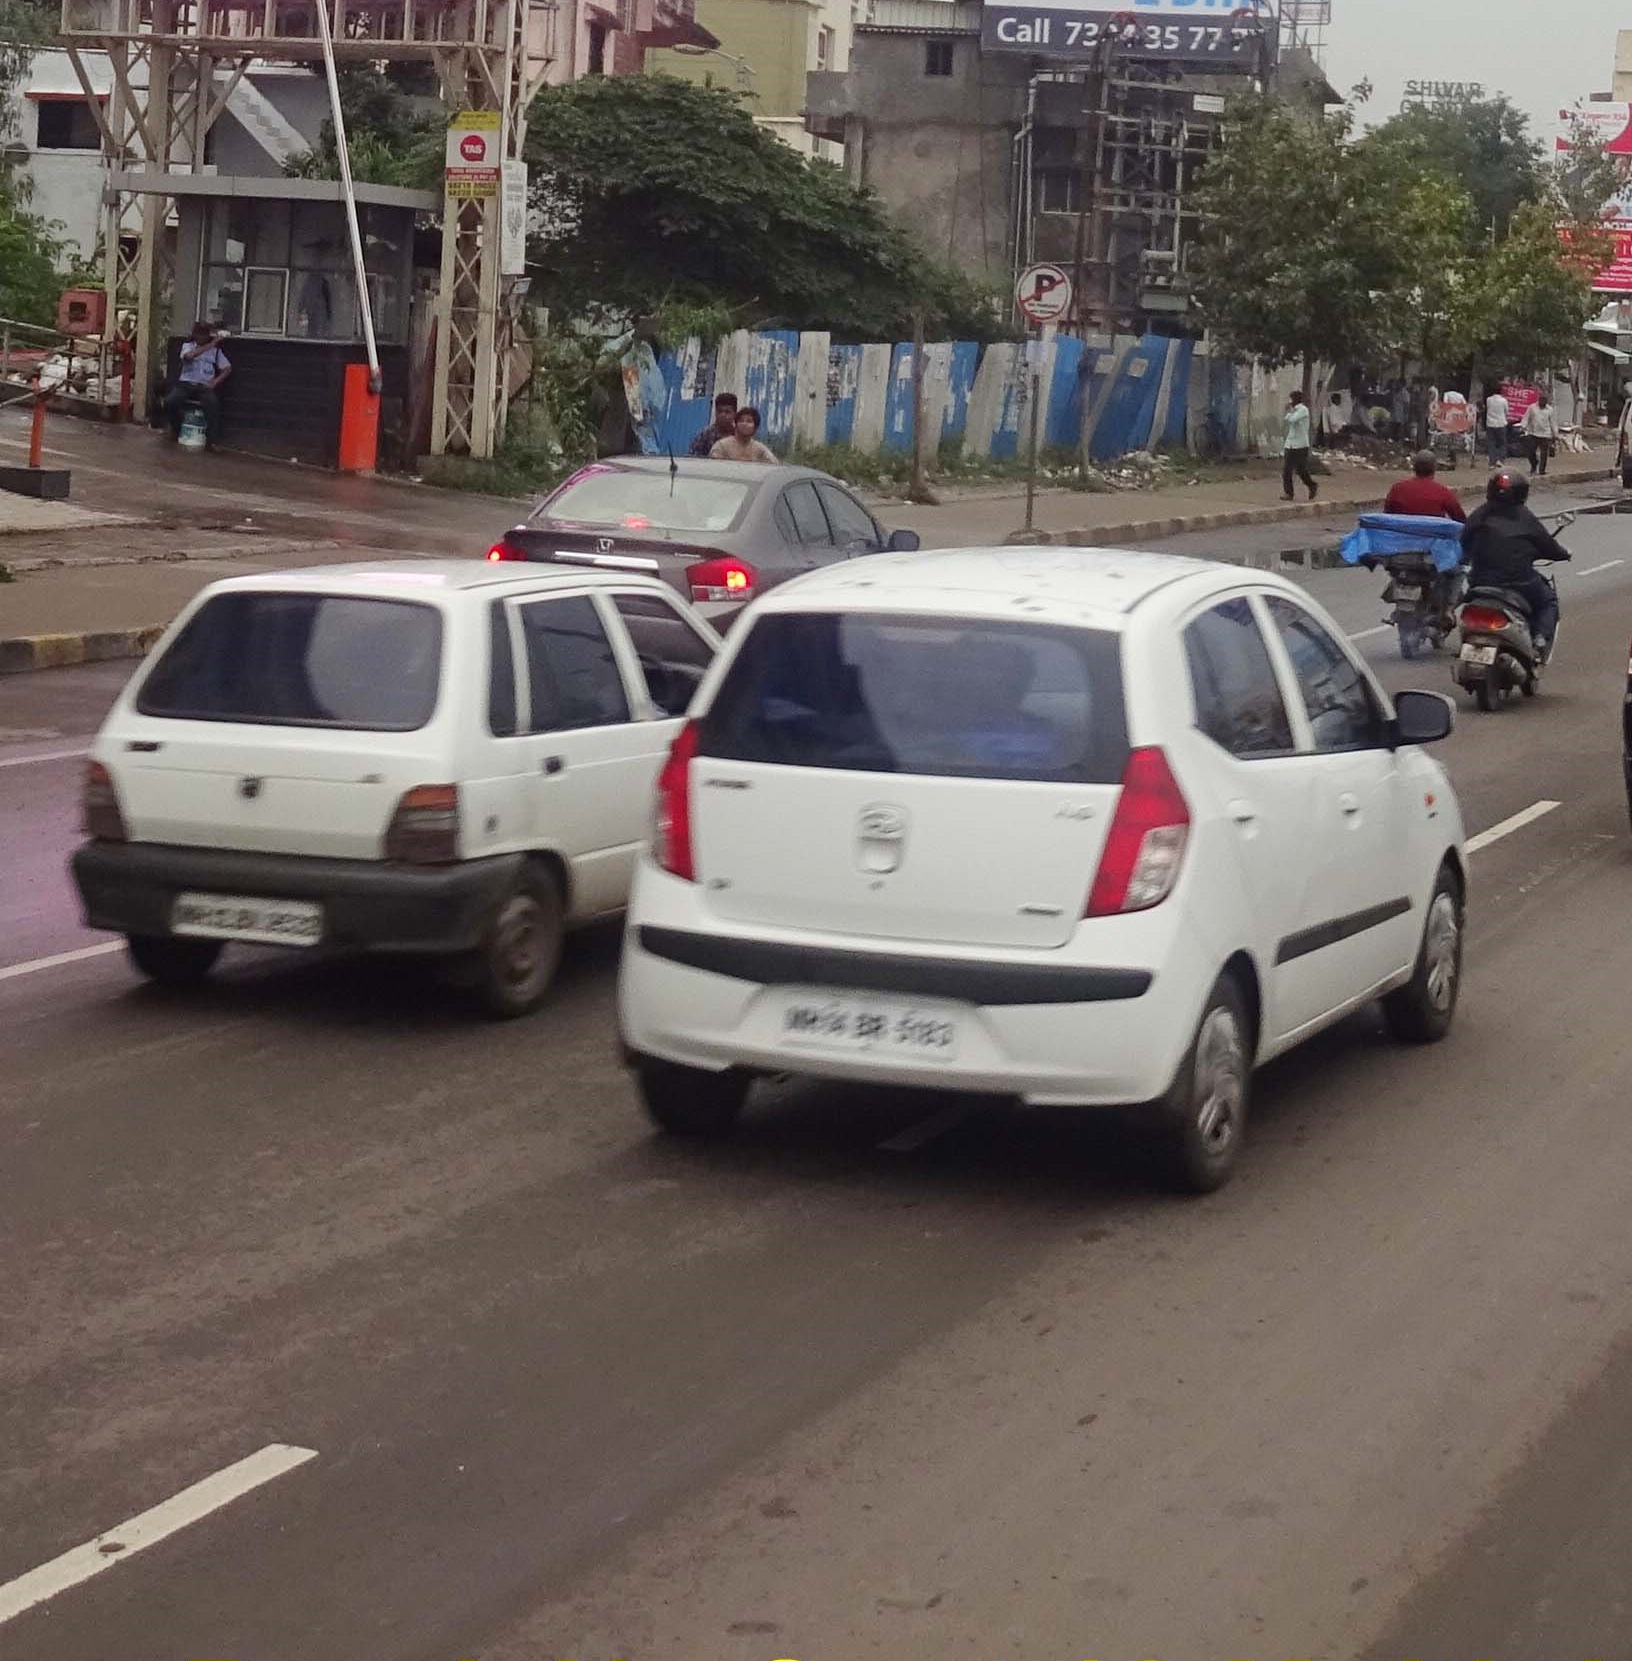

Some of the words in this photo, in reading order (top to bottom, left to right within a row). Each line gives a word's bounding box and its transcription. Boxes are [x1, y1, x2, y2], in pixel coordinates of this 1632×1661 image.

[996, 17, 1051, 44] Call
[1188, 26, 1223, 51] 77
[463, 145, 483, 155] TAS
[1034, 274, 1057, 301] P
